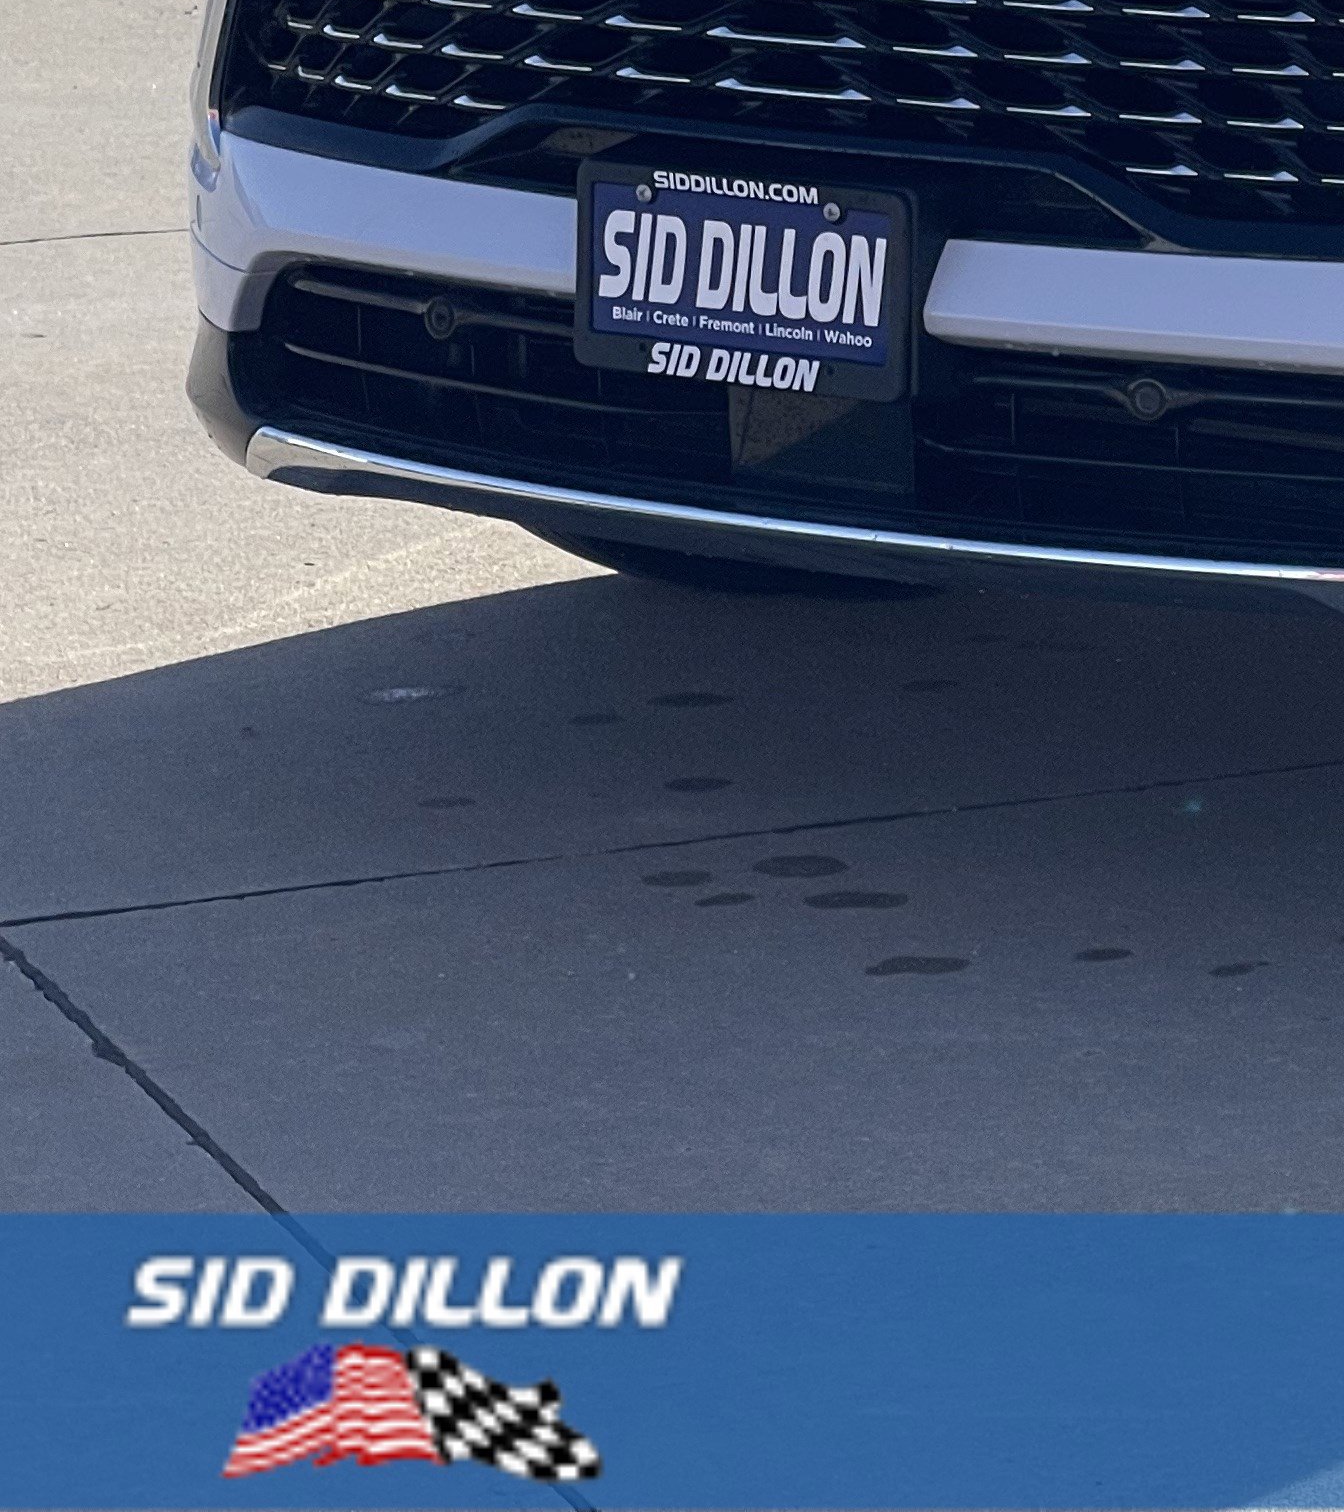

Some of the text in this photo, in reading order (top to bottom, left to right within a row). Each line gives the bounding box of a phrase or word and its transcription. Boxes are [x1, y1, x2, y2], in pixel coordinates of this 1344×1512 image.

[653, 170, 819, 205] SIDDILLON.COM
[599, 209, 887, 327] SID DILLON
[612, 306, 873, 348] Blair Crete Fremont Lincoln Wahoo
[647, 342, 820, 392] SID DILLON
